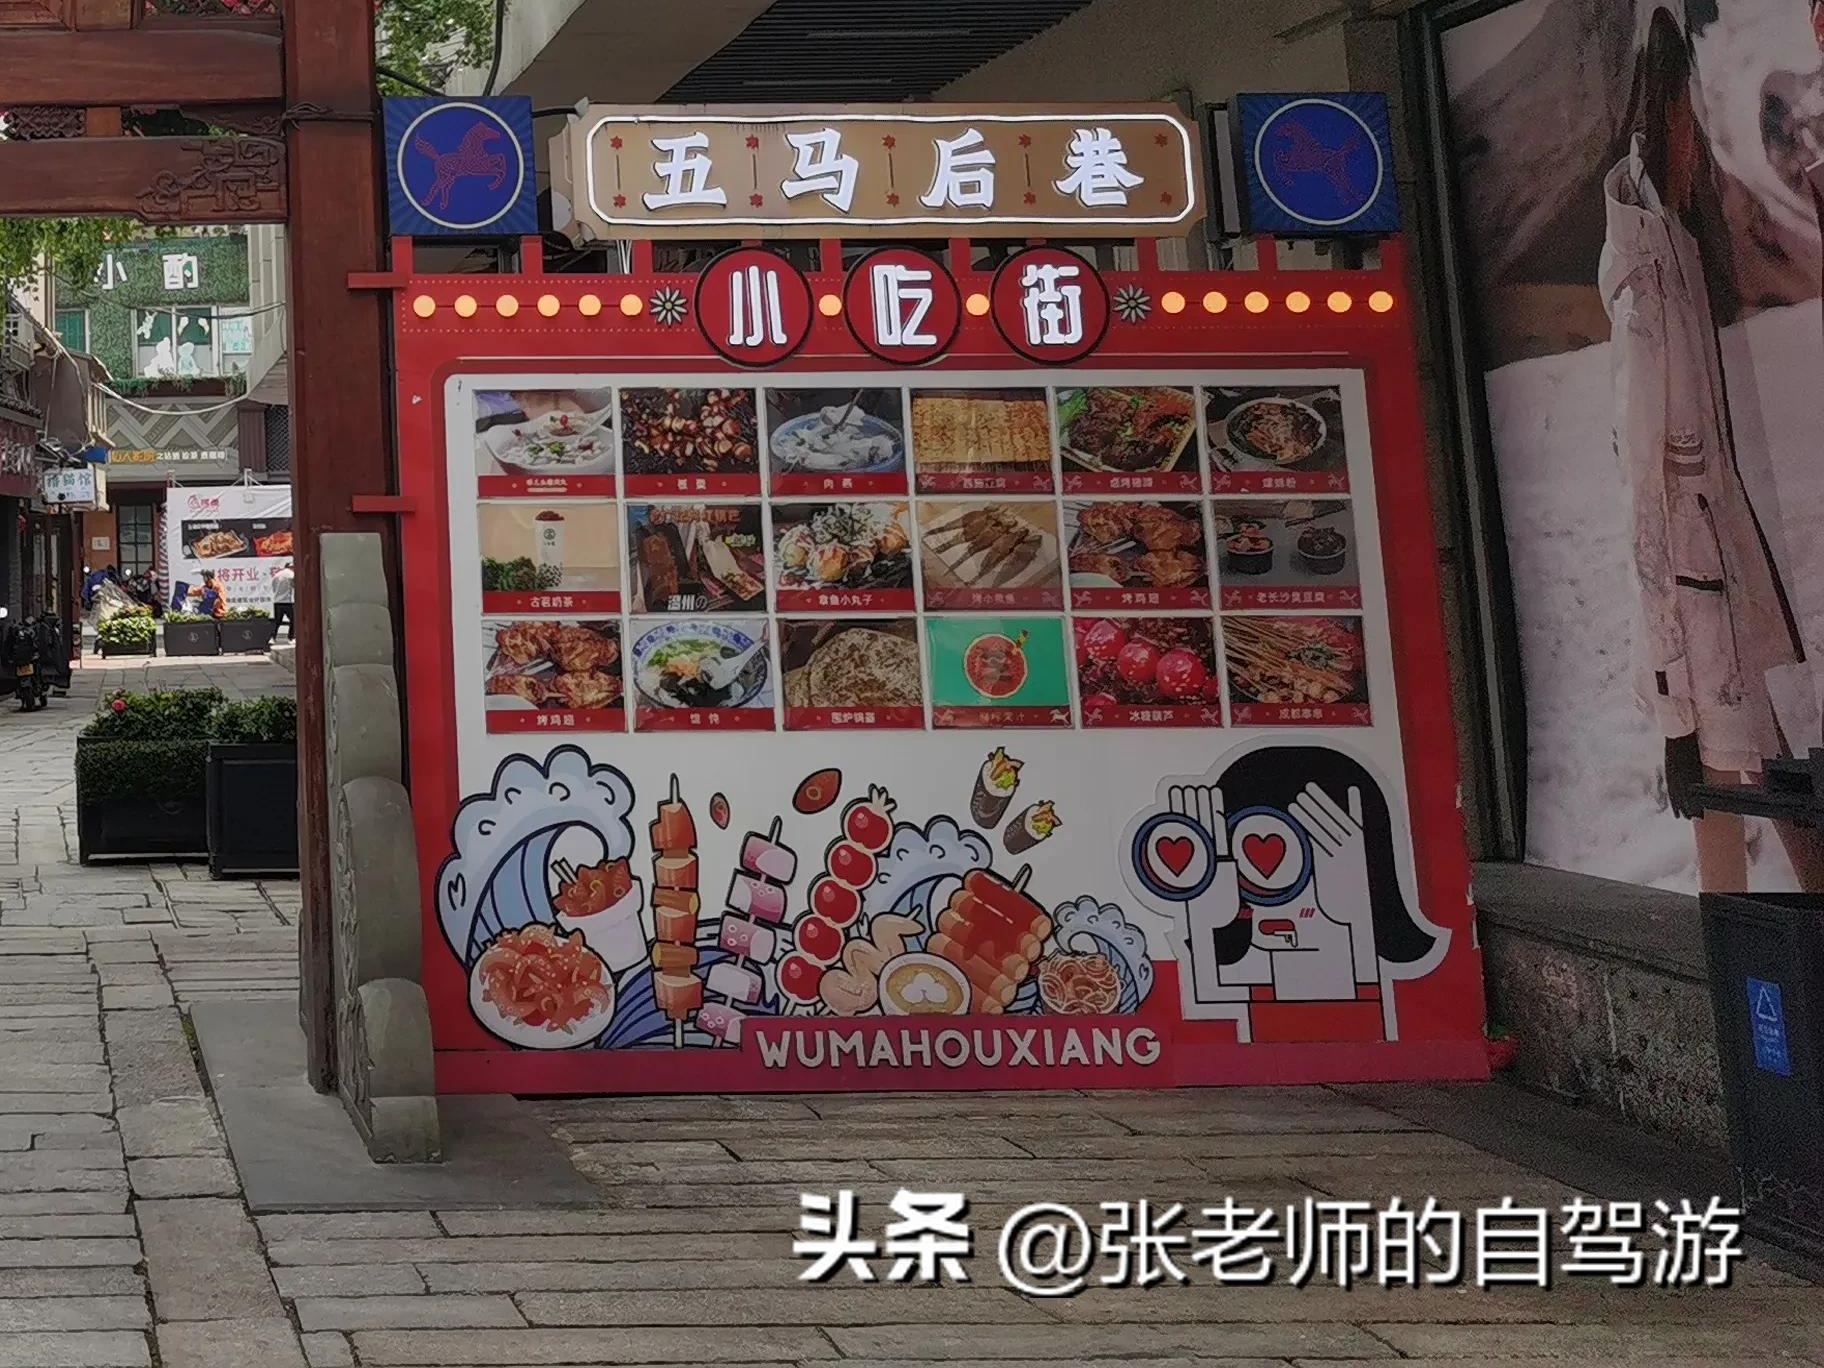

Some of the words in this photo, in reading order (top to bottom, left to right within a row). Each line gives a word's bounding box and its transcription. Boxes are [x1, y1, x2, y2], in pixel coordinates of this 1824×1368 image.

[641, 127, 1144, 210] 五马后巷
[727, 263, 1084, 348] 小吃街
[818, 593, 874, 607] 章鱼小丸子
[1128, 709, 1175, 722] 冰糖葫芦
[756, 1024, 1161, 1069] WUMAHOUXIANG
